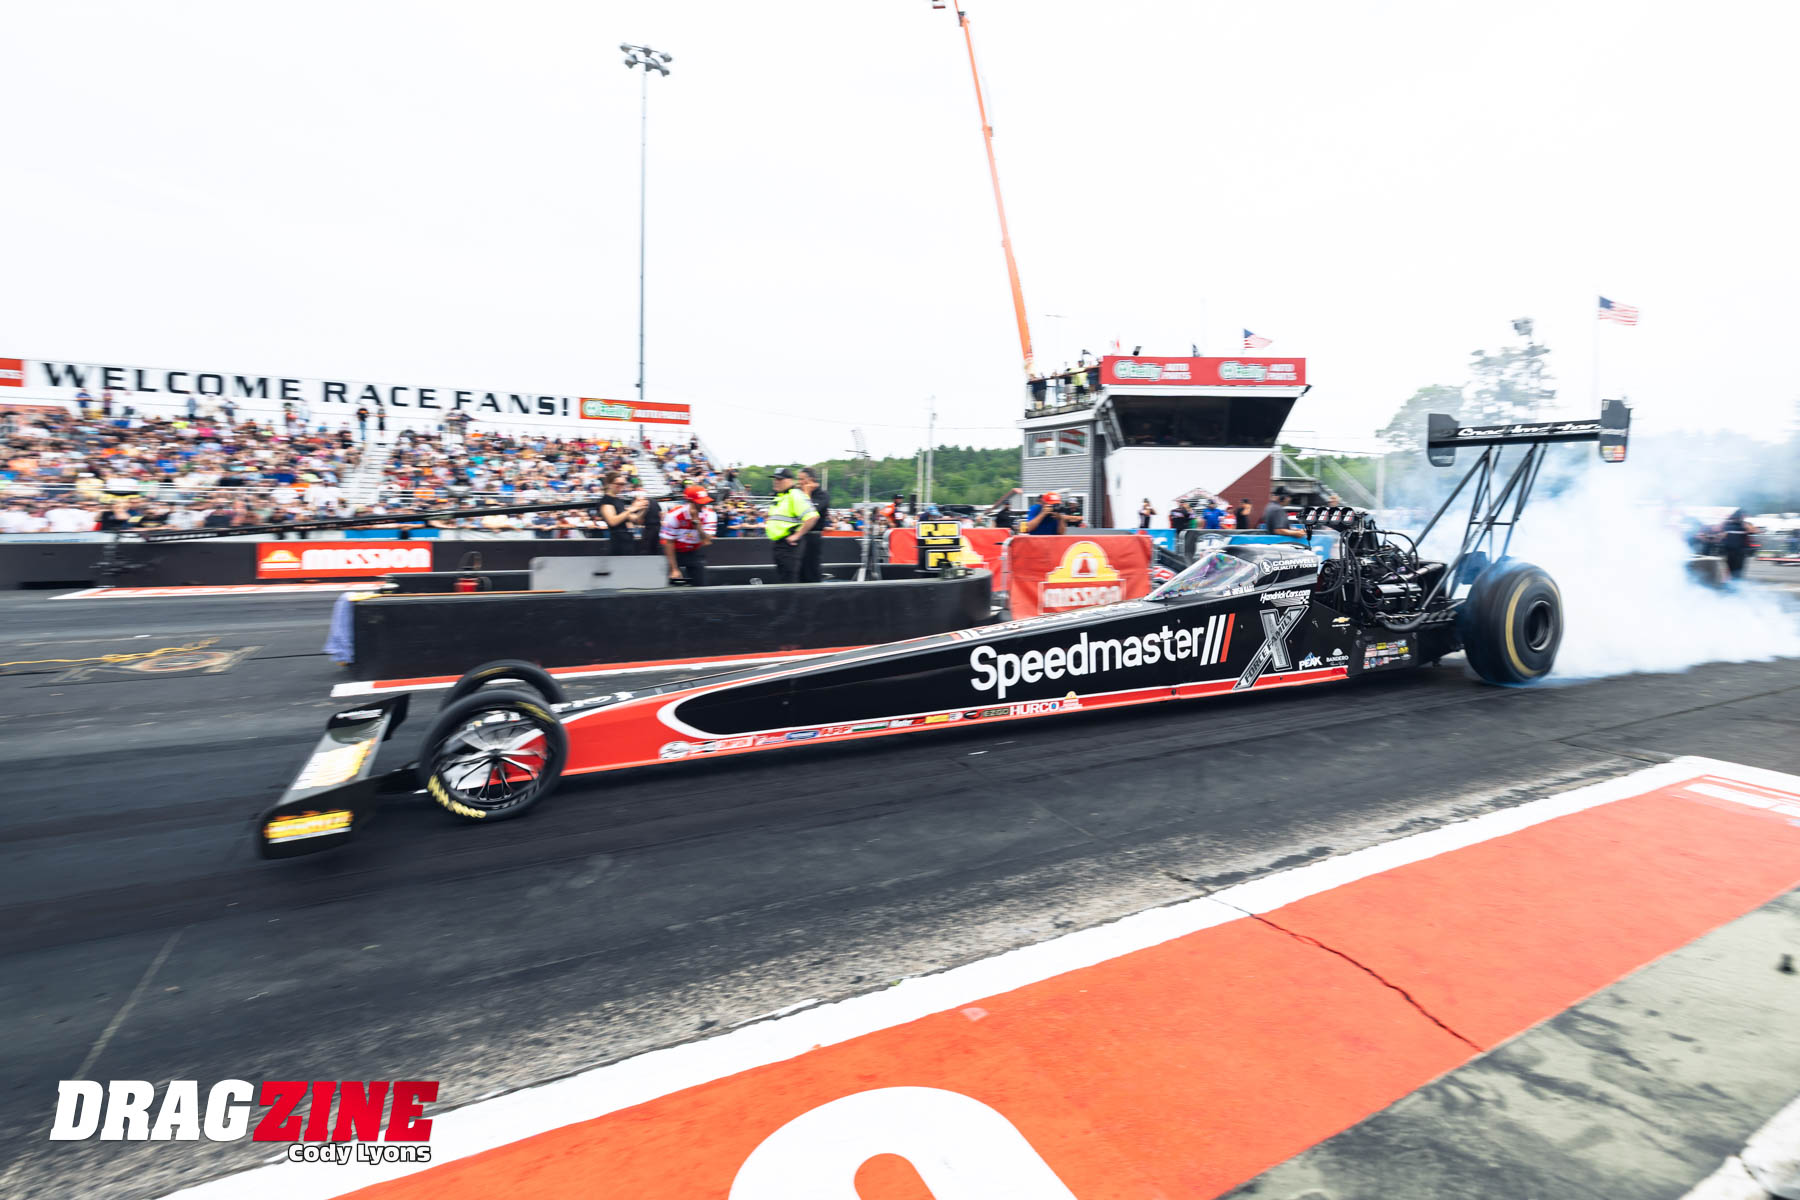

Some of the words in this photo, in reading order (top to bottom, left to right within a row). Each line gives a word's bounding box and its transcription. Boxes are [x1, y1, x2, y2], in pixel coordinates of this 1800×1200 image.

[42, 362, 303, 400] WELCOME
[323, 381, 441, 409] RACE
[455, 390, 568, 416] FANS!
[1272, 558, 1316, 567] CORNWELL
[970, 625, 1204, 699] Speedmaster
[1244, 648, 1269, 684] FORCE
[1266, 612, 1294, 651] FAMILY
[1299, 656, 1323, 670] PEAK
[1010, 701, 1060, 716] HURCO
